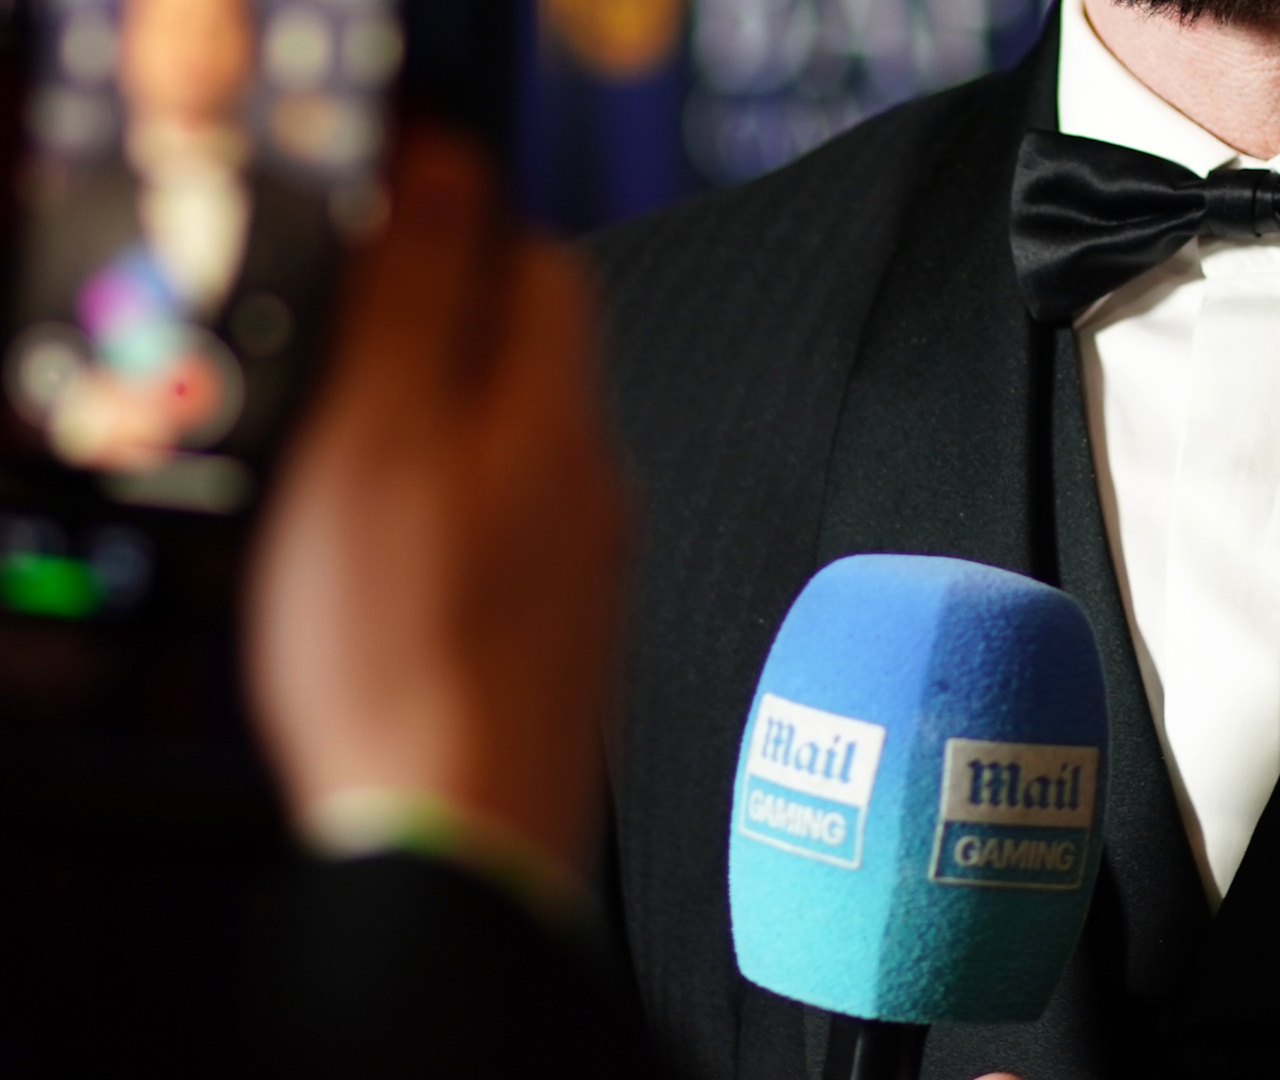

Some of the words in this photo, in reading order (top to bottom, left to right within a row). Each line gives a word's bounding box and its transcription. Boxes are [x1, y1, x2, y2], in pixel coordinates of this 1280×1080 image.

[761, 716, 857, 784] Mail
[968, 758, 1081, 810] Mail
[749, 788, 847, 847] GAMING
[953, 835, 1077, 872] GAMING
